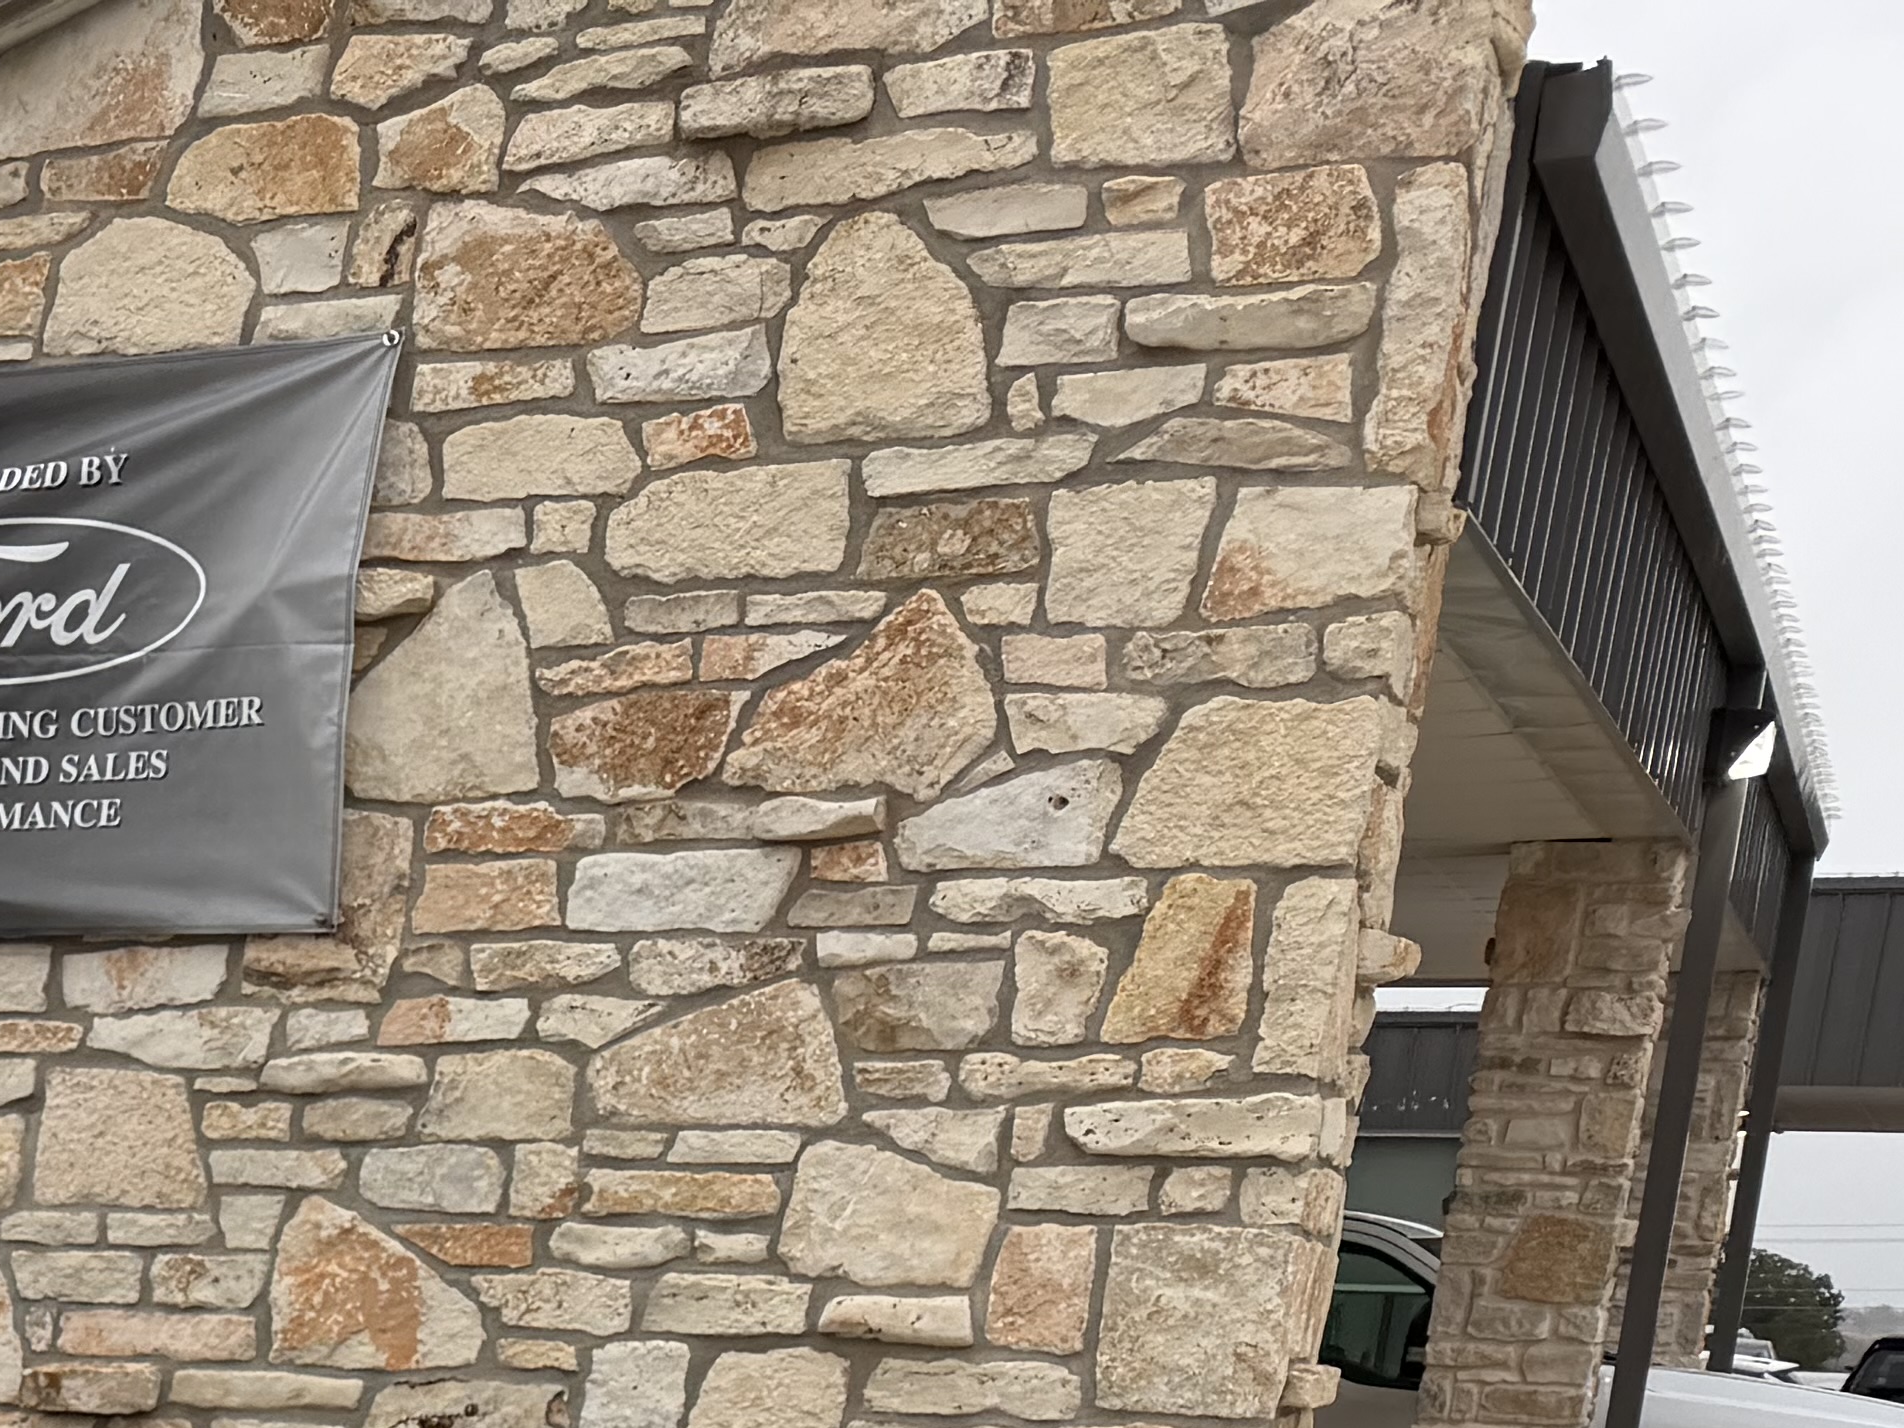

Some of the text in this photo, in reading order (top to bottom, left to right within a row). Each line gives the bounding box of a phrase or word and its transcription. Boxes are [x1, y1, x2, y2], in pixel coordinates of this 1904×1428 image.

[78, 451, 129, 487] BY
[70, 696, 264, 738] CUSTOMER
[58, 749, 169, 783] SALES
